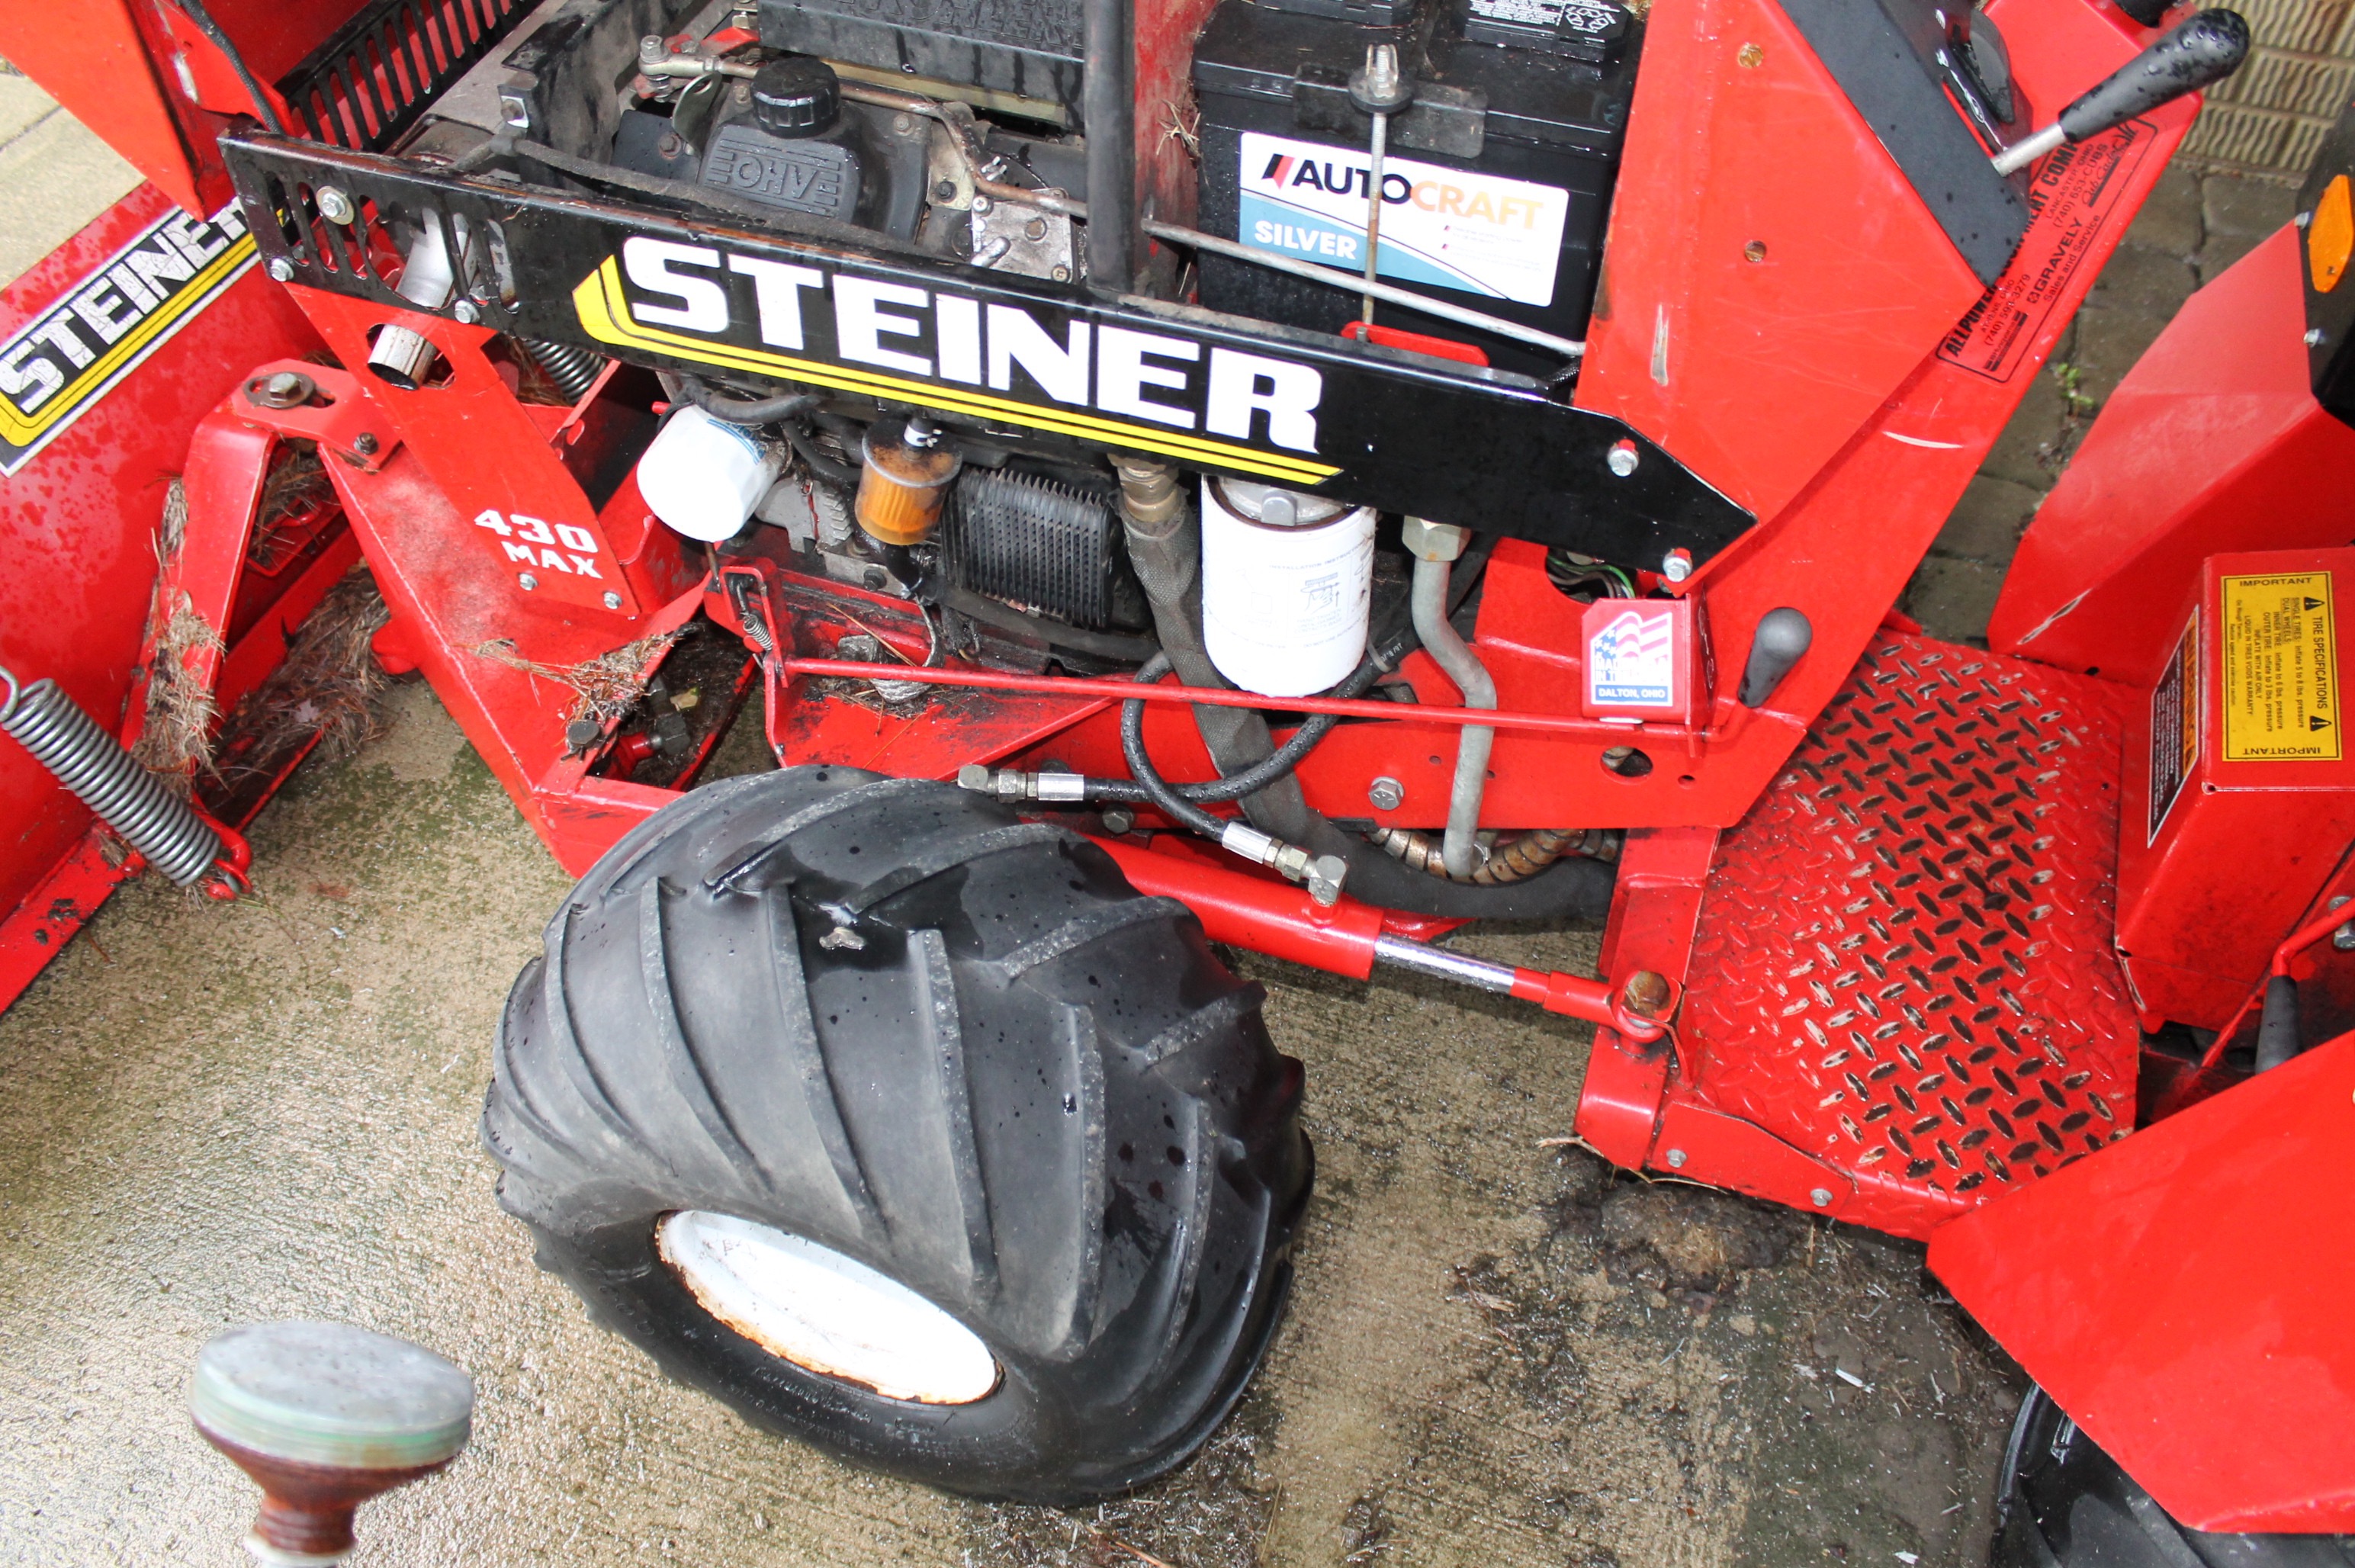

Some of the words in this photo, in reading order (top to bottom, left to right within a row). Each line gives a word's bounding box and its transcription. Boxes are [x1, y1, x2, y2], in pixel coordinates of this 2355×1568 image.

[732, 156, 819, 199] OHV
[1292, 159, 1543, 230] AUTOCRAFT
[2045, 165, 2080, 220] LANCASTER,
[2077, 143, 2094, 166] OHIO
[2052, 199, 2076, 230] (740)
[2069, 142, 2108, 201] 653-CUBS
[1255, 220, 1357, 261] SILVER
[2033, 216, 2084, 292] GRAVELY
[2043, 273, 2065, 303] Sales
[2060, 252, 2078, 274] and
[2073, 213, 2101, 253] Service
[623, 236, 1322, 455] STEINER
[1984, 319, 2005, 347] (740)
[474, 509, 599, 553] 430
[500, 541, 603, 579] MAX
[2240, 577, 2312, 587] IMPORTANT
[2312, 617, 2323, 635] TIRE
[1598, 688, 1640, 699] DALTON,
[1641, 689, 1666, 699] OHIO
[2314, 638, 2327, 708] SPECIFICATIONS
[2296, 699, 2304, 728] pressure
[2243, 747, 2321, 756] IMPORTANT
